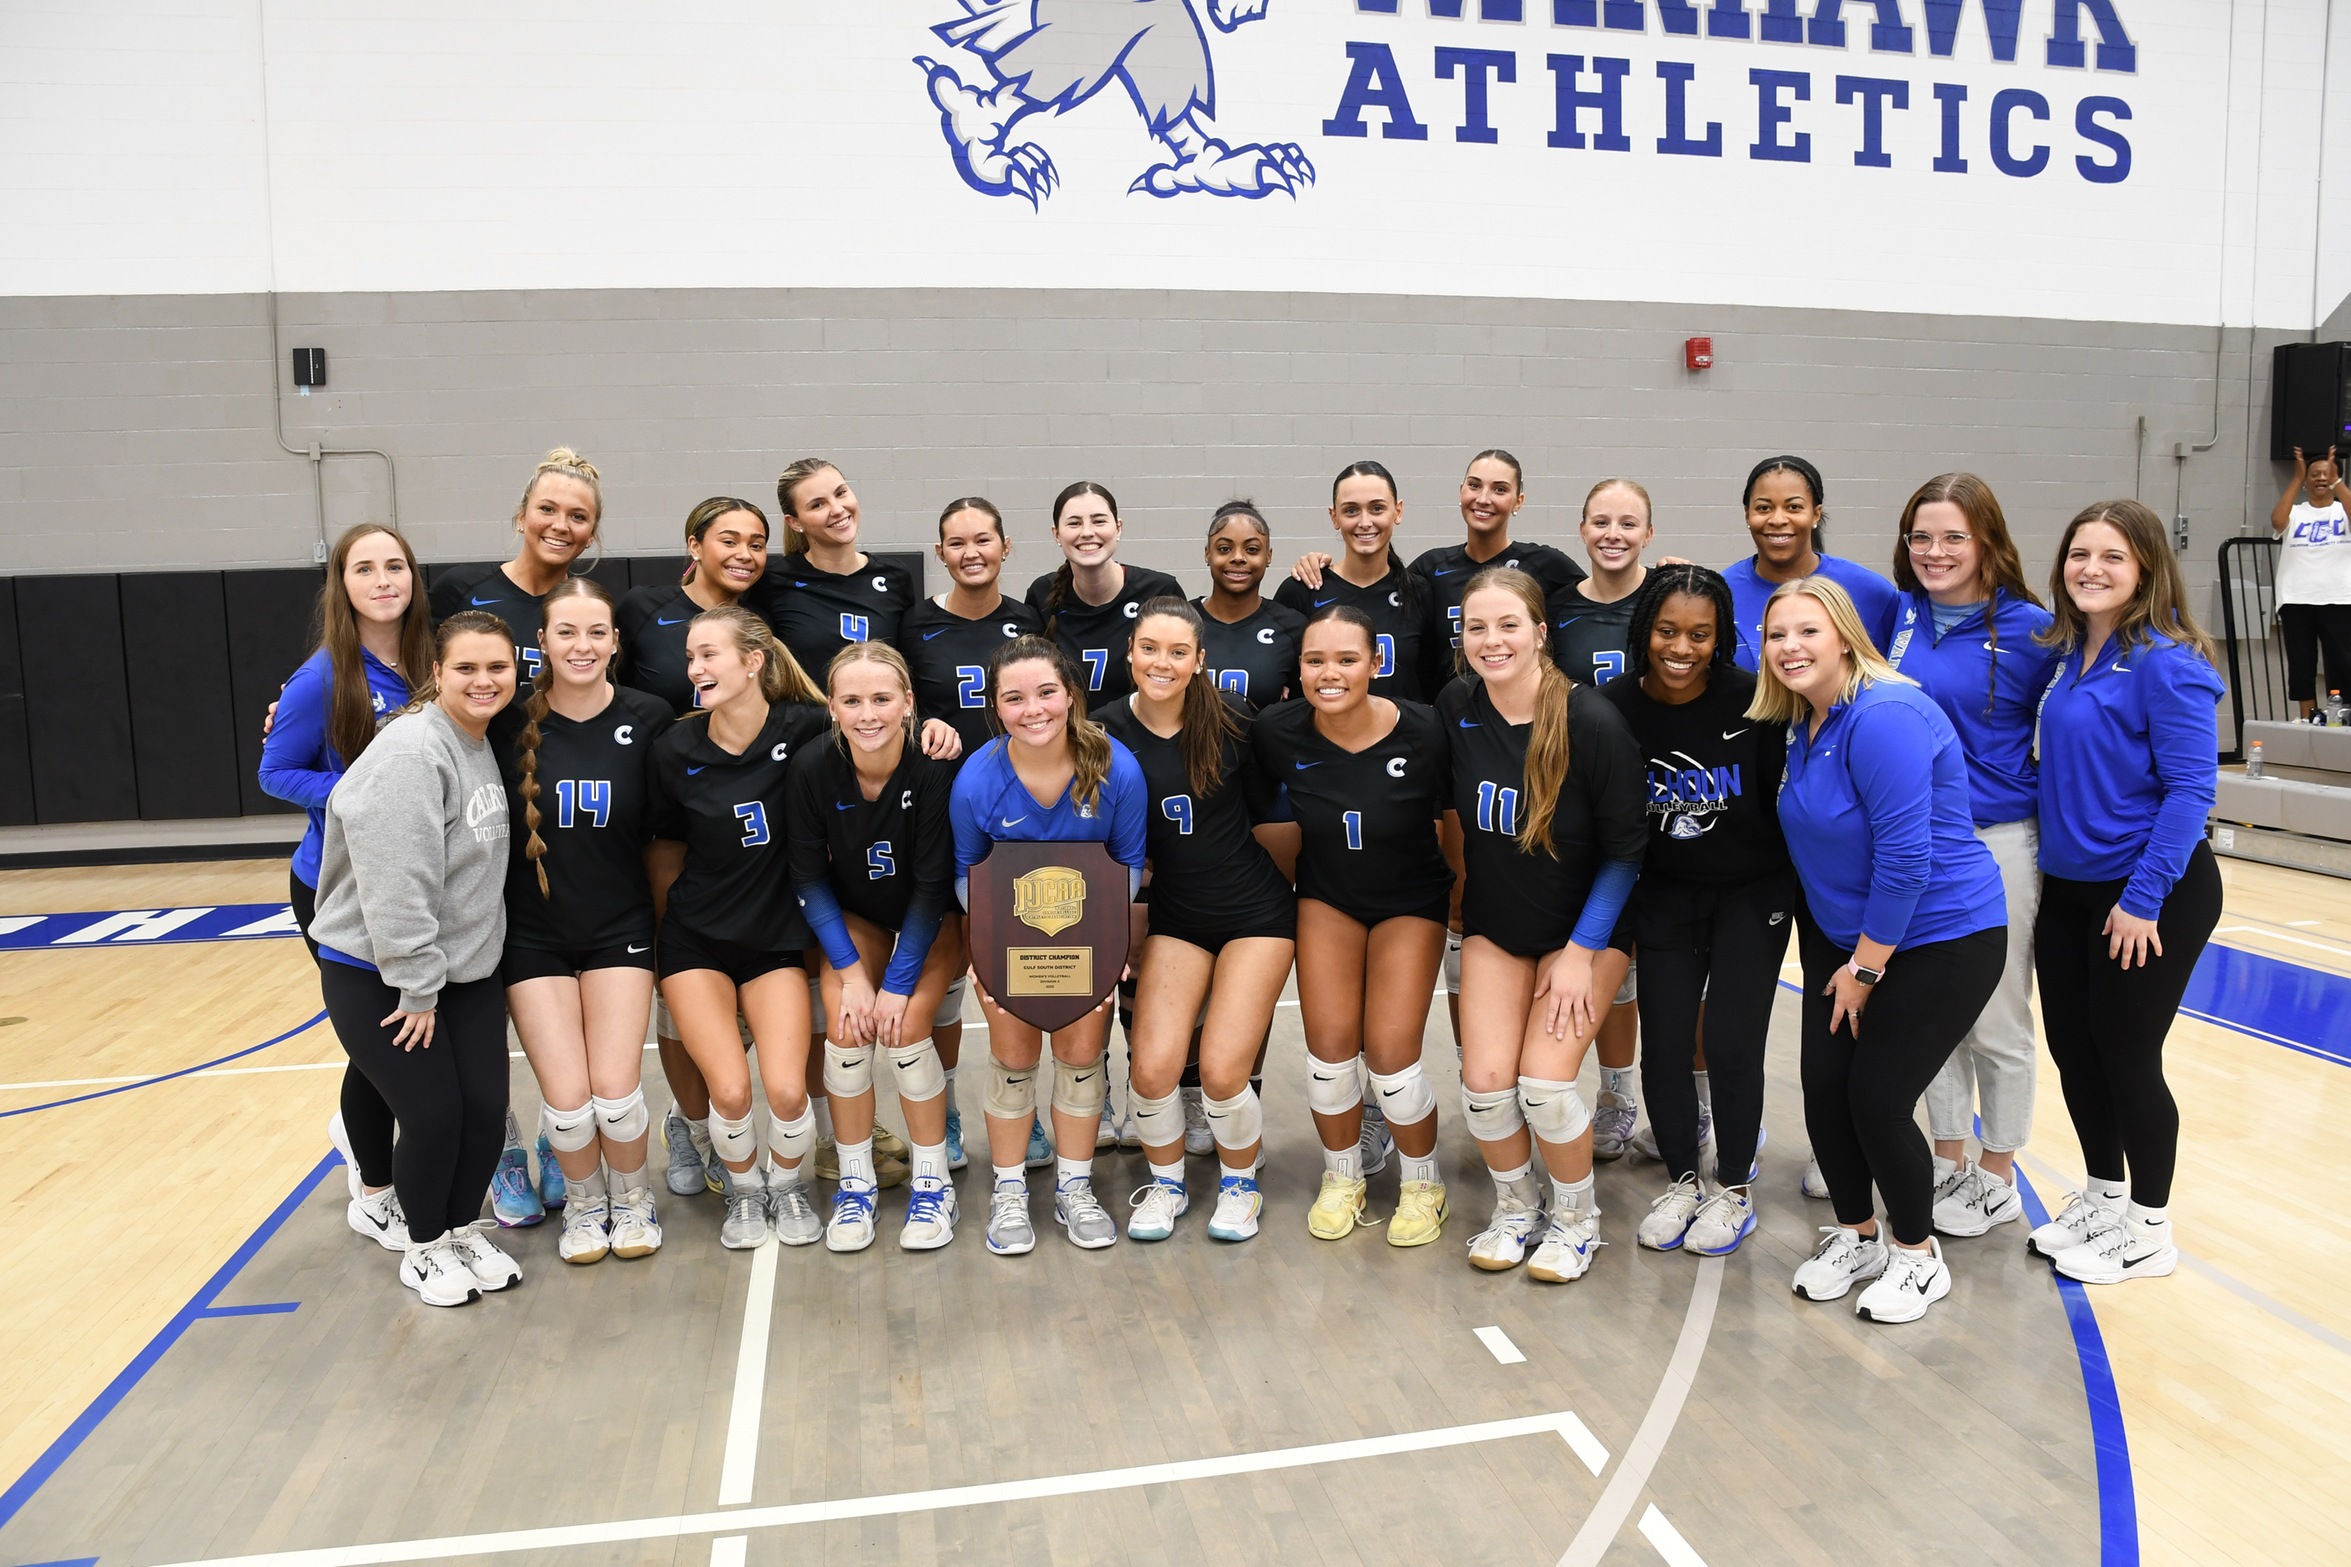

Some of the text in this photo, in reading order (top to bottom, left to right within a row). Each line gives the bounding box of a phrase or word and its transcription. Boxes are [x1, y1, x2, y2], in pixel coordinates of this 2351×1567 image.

[1322, 41, 2133, 184] ATHLETICS
[956, 665, 993, 708] 2
[1082, 648, 1108, 691] 7
[555, 779, 611, 828] 14
[733, 800, 771, 847] 3
[1161, 794, 1193, 835] 9
[1477, 780, 1518, 836] 11
[1342, 810, 1362, 850] 1
[866, 841, 896, 880] 5
[1017, 879, 1084, 912] NJCAA
